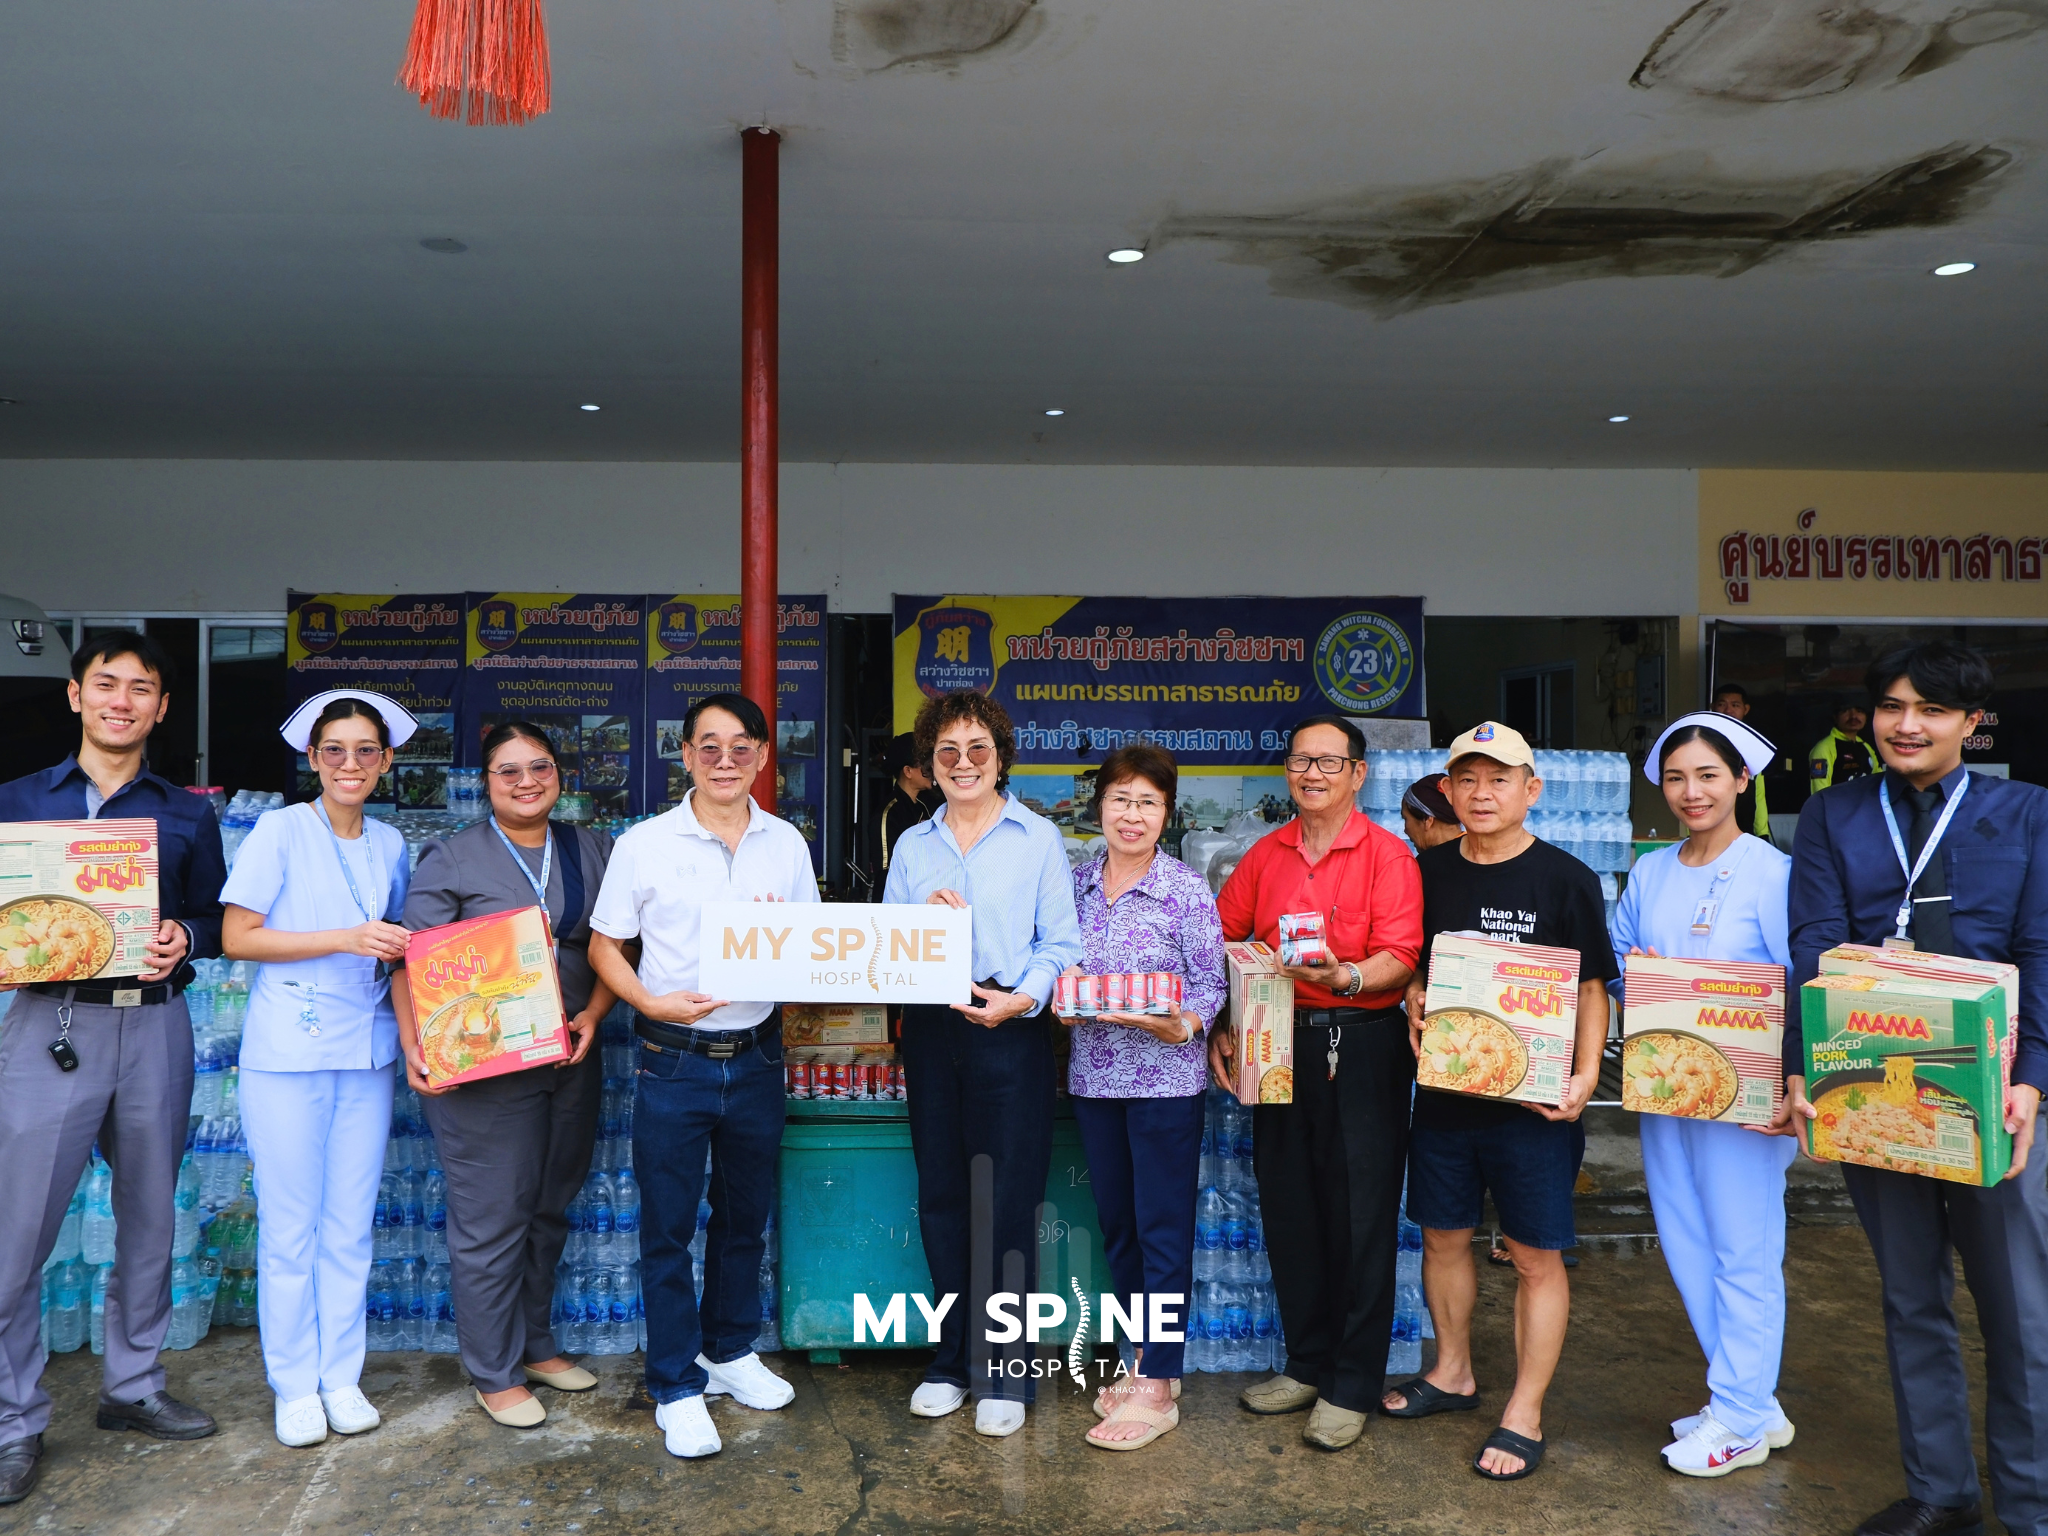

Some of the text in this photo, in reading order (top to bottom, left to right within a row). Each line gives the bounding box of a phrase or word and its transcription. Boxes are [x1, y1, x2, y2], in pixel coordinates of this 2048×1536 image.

[1720, 508, 2048, 605] ศูนย์บรรเทาสาธ
[341, 603, 458, 632] หน่วยกู้ภัย
[521, 602, 639, 632] หน่วยกู้ภัย
[1318, 615, 1408, 653] SAWANG WITCHA FOUNDATION
[1007, 626, 1304, 671] หน่วยกู้ภัยสว่างวิชชาฯ
[919, 664, 989, 677] สว่างวิชชาฯ
[1348, 649, 1378, 674] 23
[497, 679, 613, 694] งานอุบัติเหตุทางถนน
[936, 677, 973, 688] ปากช่อง
[1016, 679, 1300, 702] แผนกบรรเทาสาธารณภัย
[1327, 686, 1400, 710] PAKCHONG RESCUE
[75, 856, 146, 893] มาม่า
[1480, 907, 1537, 923] Khao Yai
[1480, 918, 1535, 934] National
[722, 926, 793, 960] MY
[1490, 931, 1521, 943] park
[423, 945, 489, 990] มาม่า
[1498, 984, 1564, 1019] มาม่า
[1700, 982, 1762, 997] รสต้มยำกุ้ง
[1697, 1008, 1769, 1032] MAMA
[1847, 1010, 1932, 1041] MAMA
[1812, 1039, 1862, 1053] MINCED
[1812, 1050, 1848, 1062] PORK
[1813, 1058, 1872, 1072] FLAVOUR
